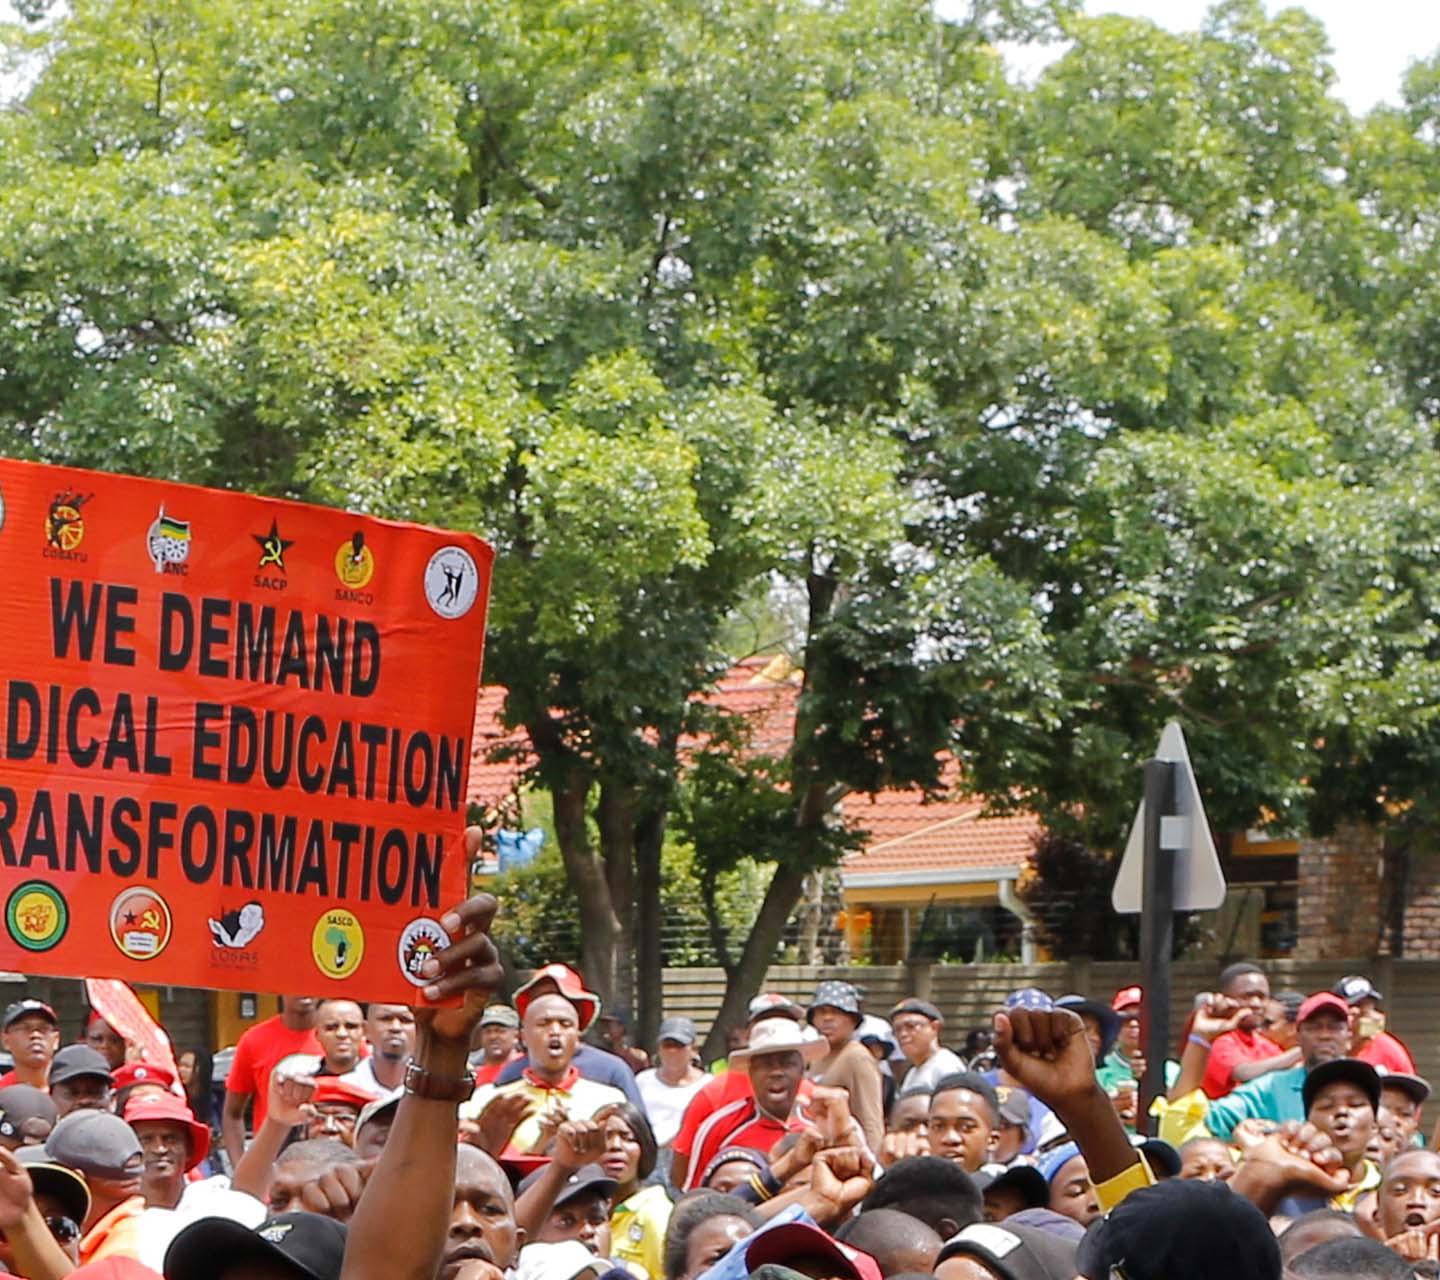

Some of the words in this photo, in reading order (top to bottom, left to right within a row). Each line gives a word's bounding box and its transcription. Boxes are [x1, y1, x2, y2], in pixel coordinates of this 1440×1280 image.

[163, 562, 189, 576] ANC
[253, 575, 288, 591] SACP
[335, 588, 374, 605] SANCO
[51, 578, 138, 665] WE
[160, 592, 381, 697] DEMAND
[192, 702, 464, 810] EDUCATION
[327, 915, 353, 927] SASCO
